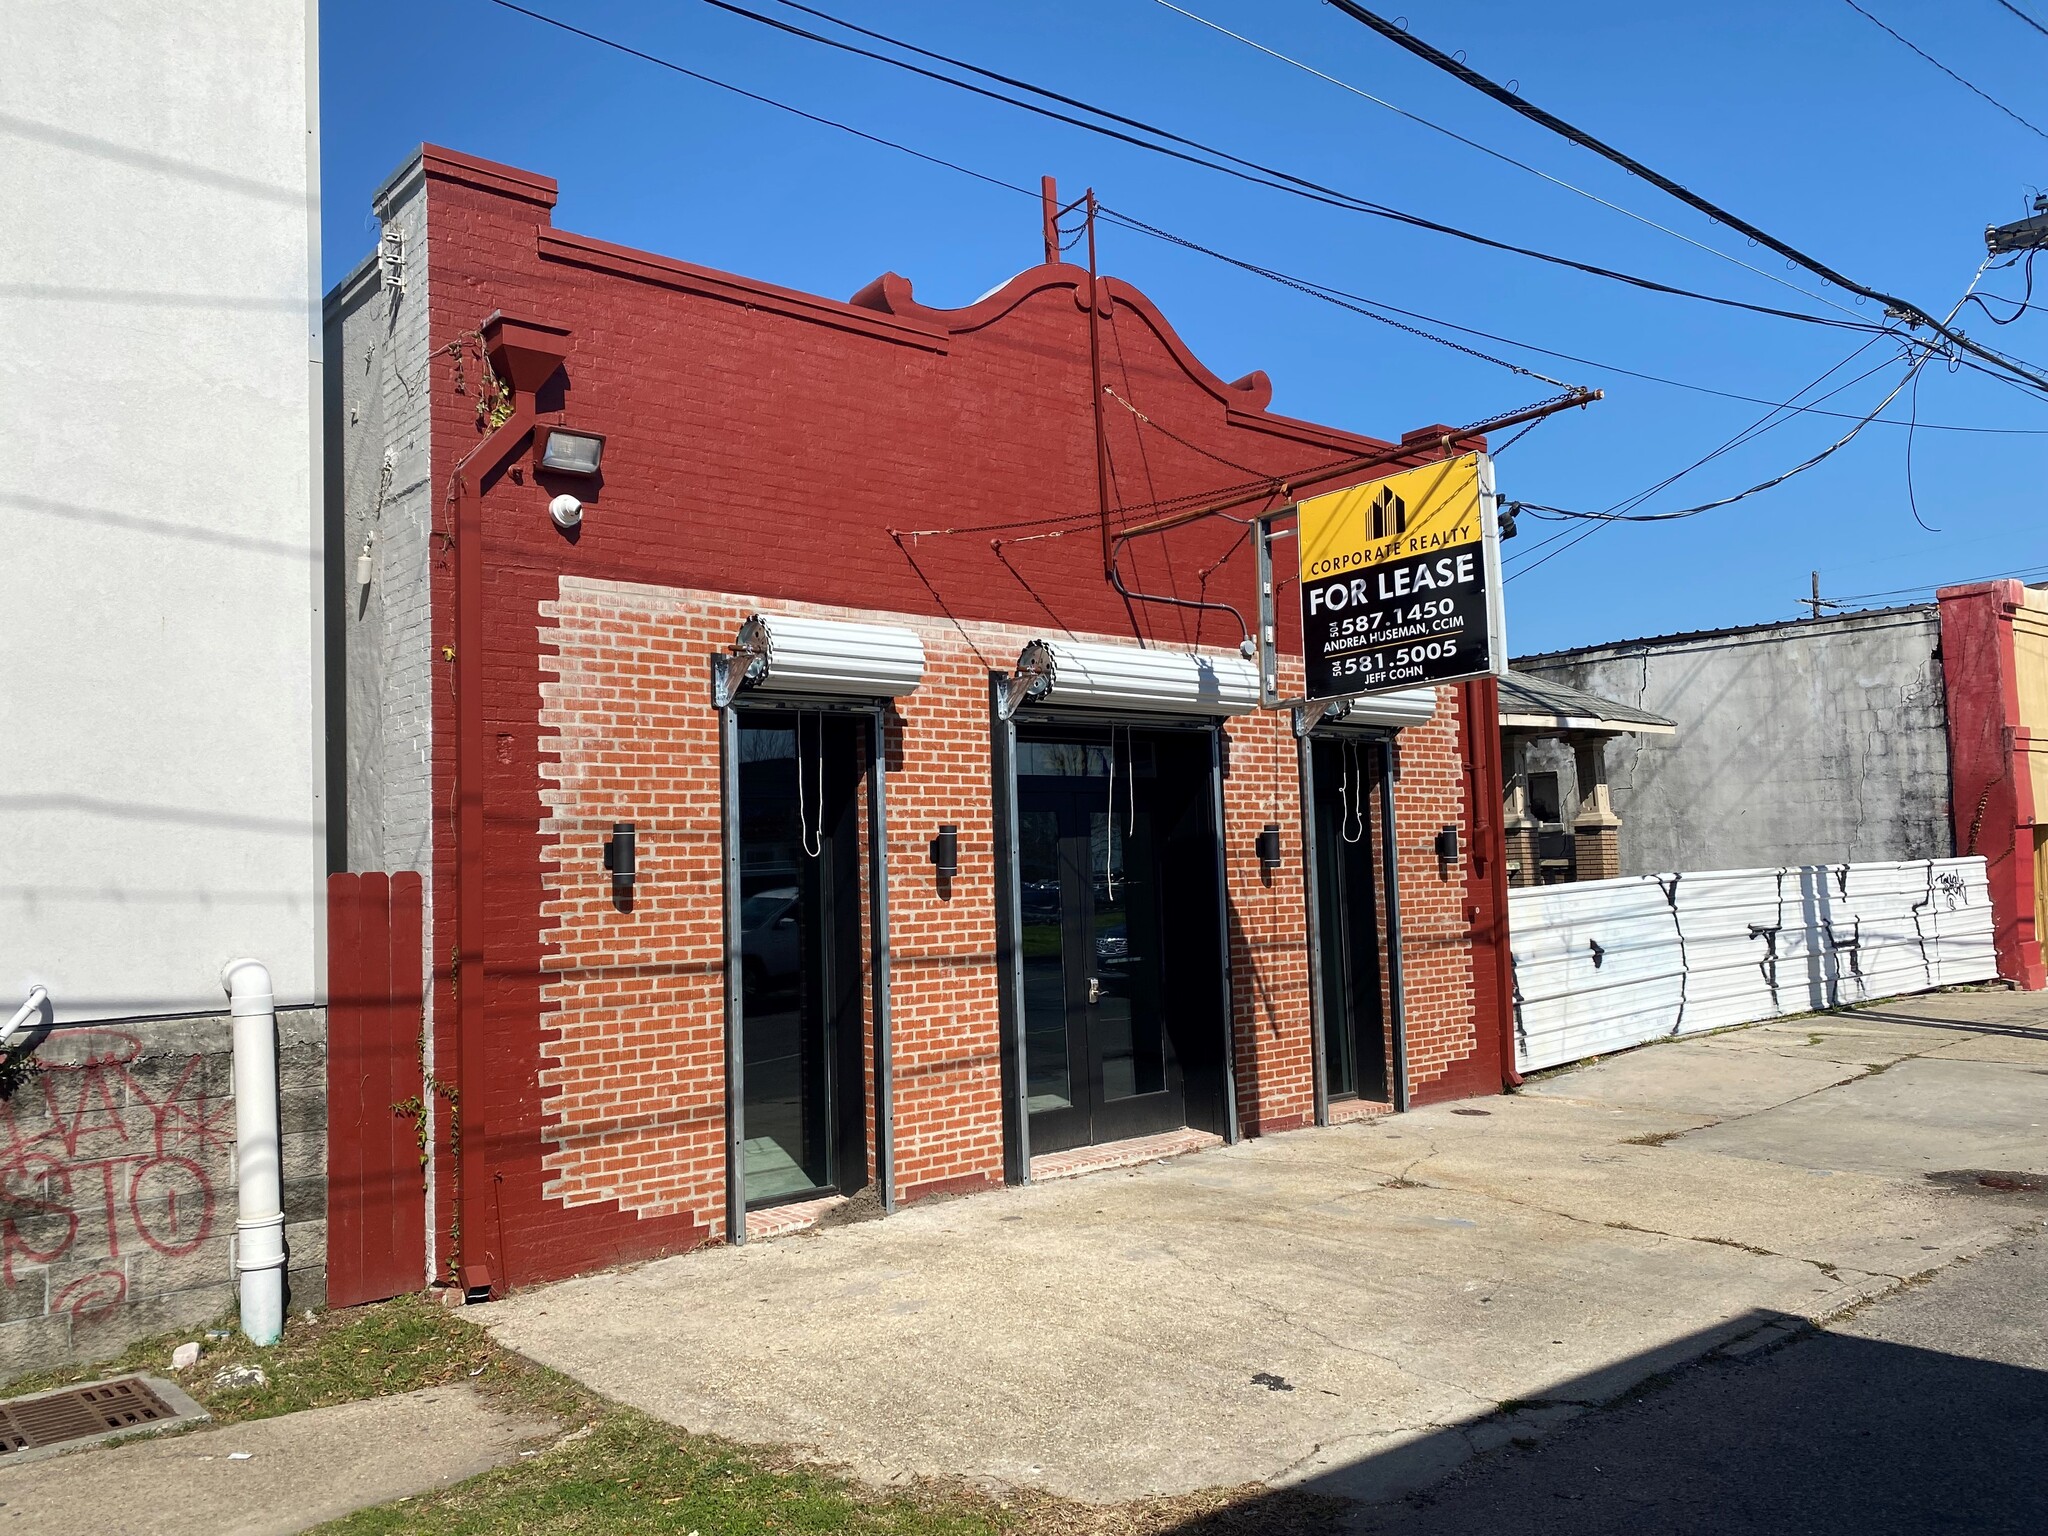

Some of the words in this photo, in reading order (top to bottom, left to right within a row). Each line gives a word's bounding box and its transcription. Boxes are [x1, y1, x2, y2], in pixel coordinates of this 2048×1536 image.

[1311, 542, 1401, 575] CORPORATE
[1410, 525, 1470, 551] REALTY
[1309, 578, 1368, 615] FOR
[1378, 553, 1475, 600] LEASE
[1323, 632, 1367, 653] ANDREA
[1369, 623, 1429, 644] HUSEMAN,
[1432, 615, 1464, 631] CCIM
[1329, 621, 1339, 638] 504
[1341, 598, 1455, 635] 587.1450
[1332, 660, 1342, 677] 504
[1344, 640, 1457, 675] 581.5005
[1364, 671, 1387, 685] JEFF
[1389, 665, 1424, 680] COHN
